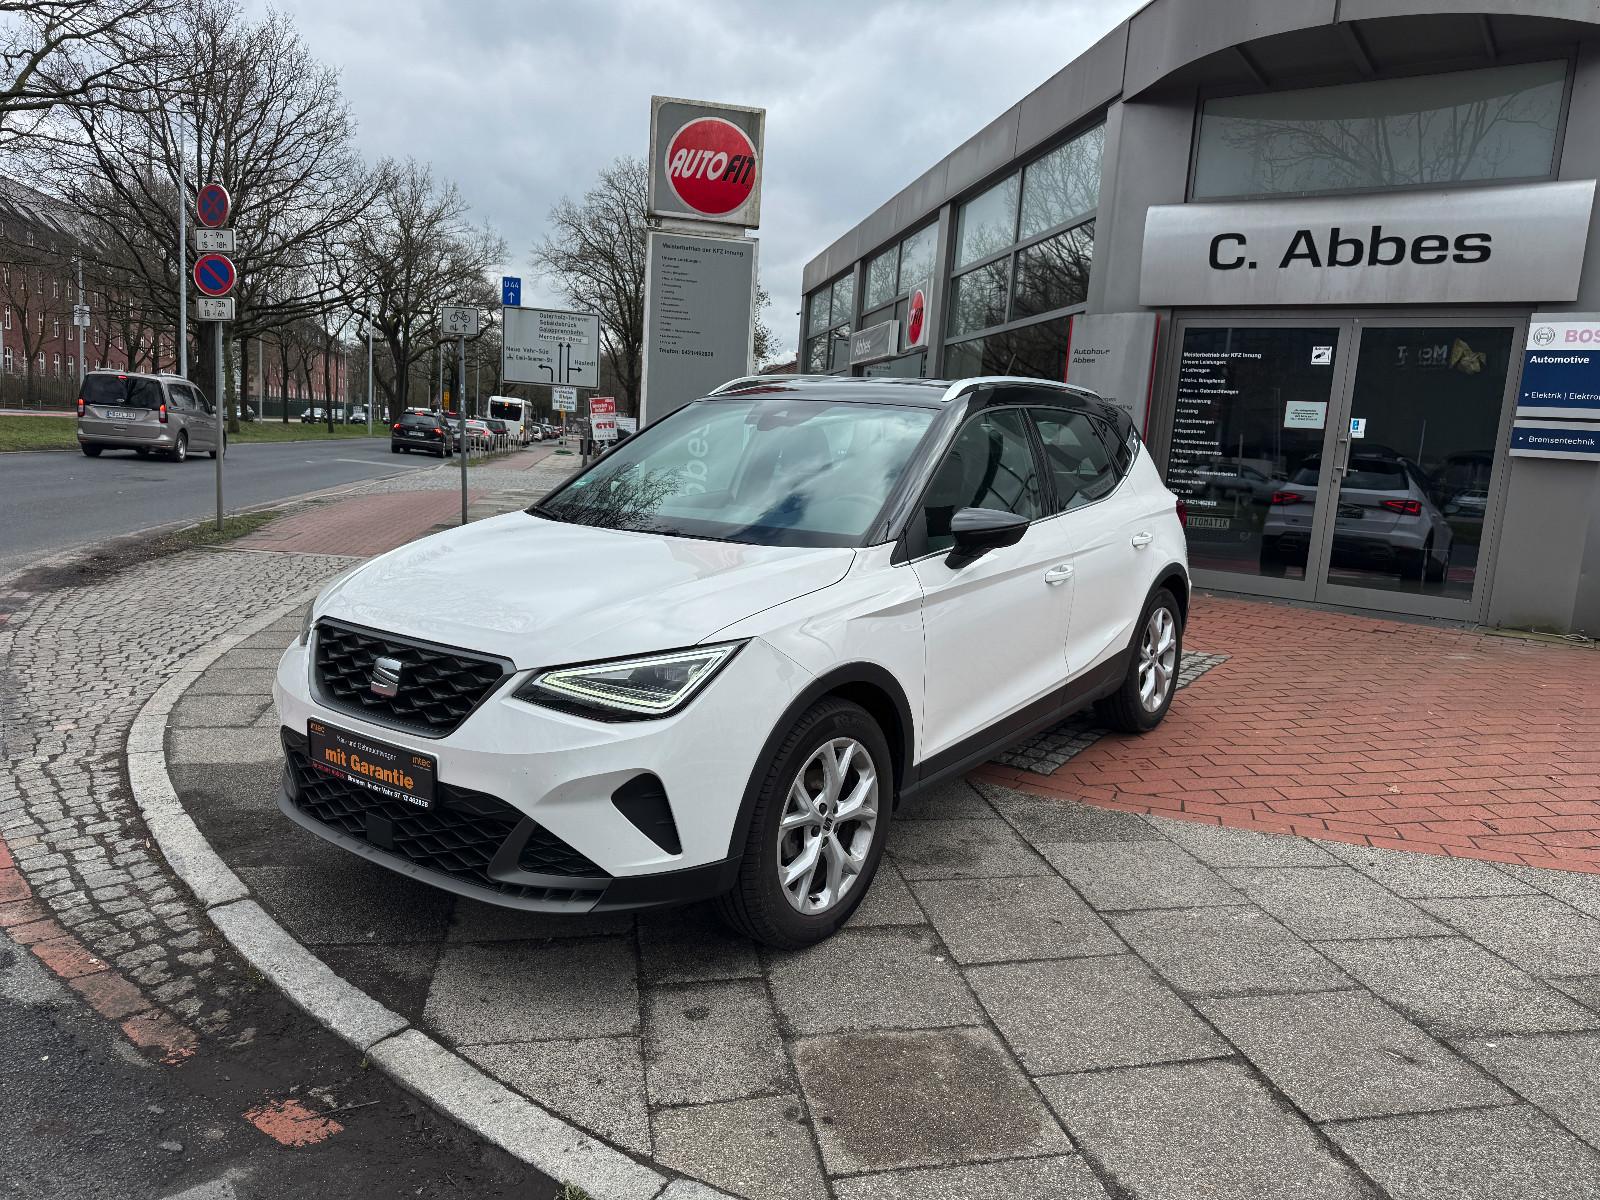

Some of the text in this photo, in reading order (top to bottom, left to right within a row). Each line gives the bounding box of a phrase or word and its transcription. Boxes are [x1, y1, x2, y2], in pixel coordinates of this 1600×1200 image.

[670, 148, 756, 185] AUTOFIT
[1208, 225, 1492, 270] C. Abbes
[1530, 355, 1590, 364] Automotive
[1528, 436, 1595, 446] Bremsentechnik
[1188, 517, 1228, 528] UTOMATIK
[326, 747, 346, 767] mit
[350, 754, 414, 789] Garantie
